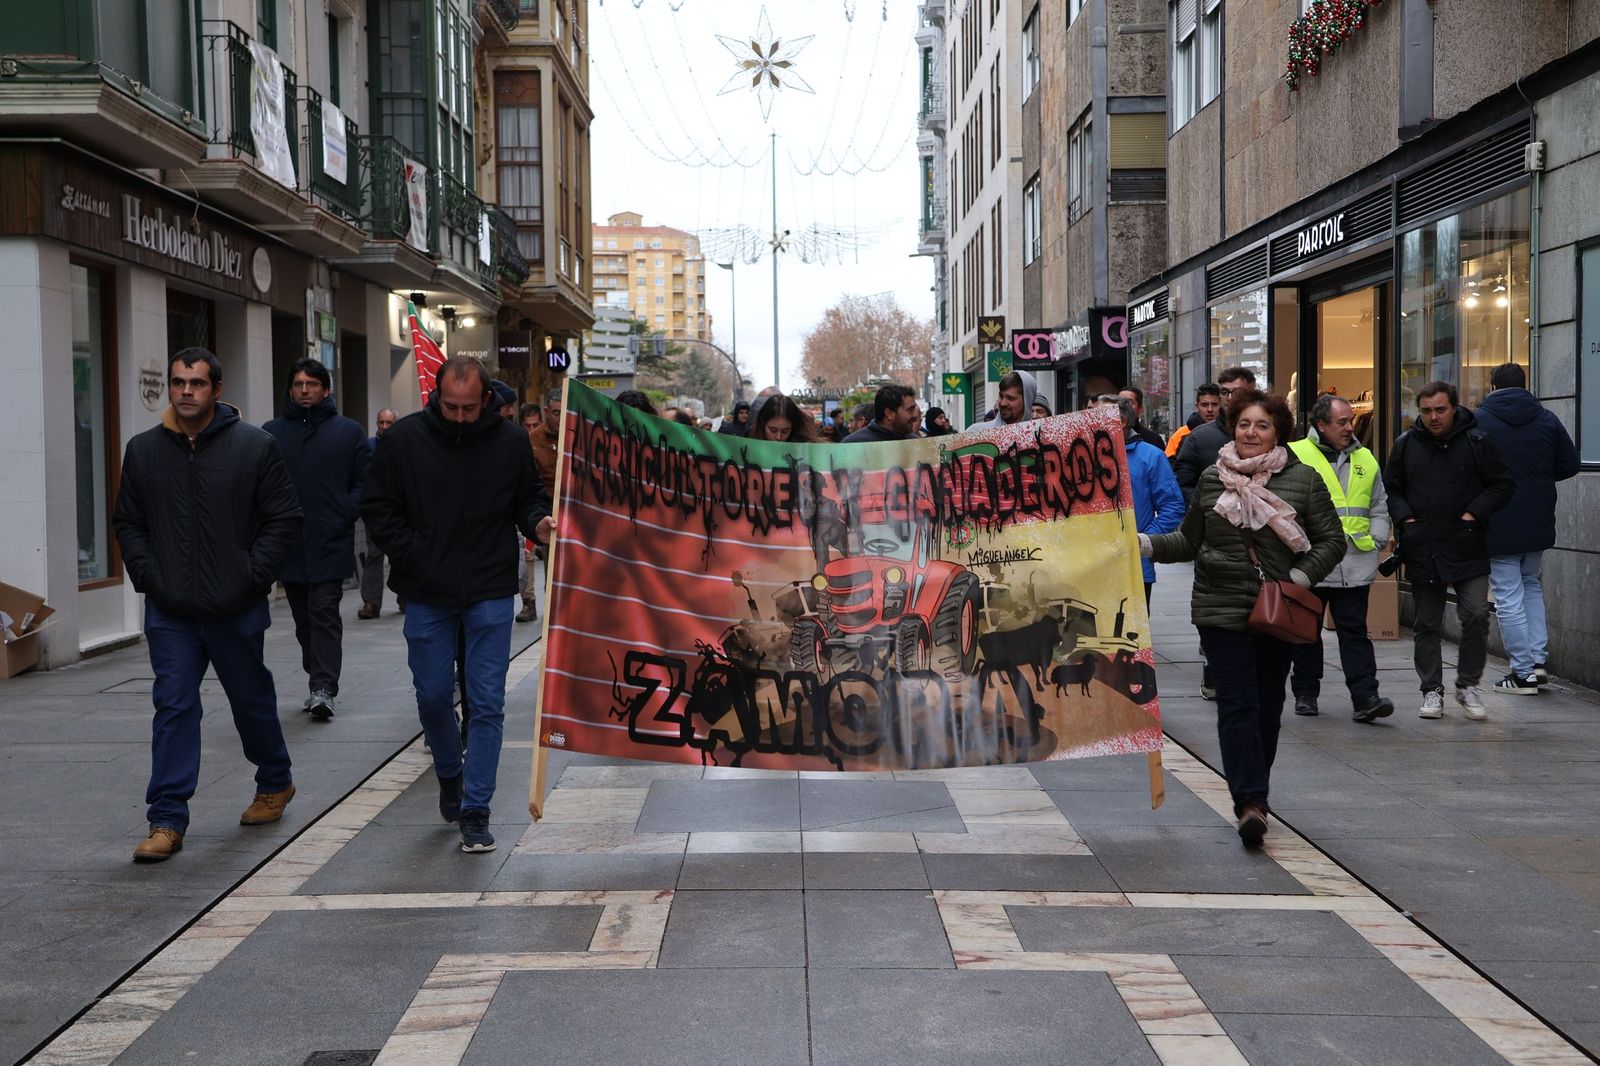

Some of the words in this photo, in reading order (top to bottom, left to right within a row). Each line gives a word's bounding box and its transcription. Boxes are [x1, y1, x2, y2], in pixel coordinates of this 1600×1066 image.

[121, 193, 210, 269] Herbolario
[1298, 213, 1344, 258] PARFOIS
[549, 353, 566, 367] IN
[588, 380, 611, 388] ONCE
[885, 428, 1122, 535] GANADEROS
[622, 648, 1041, 762] ZAMORA
